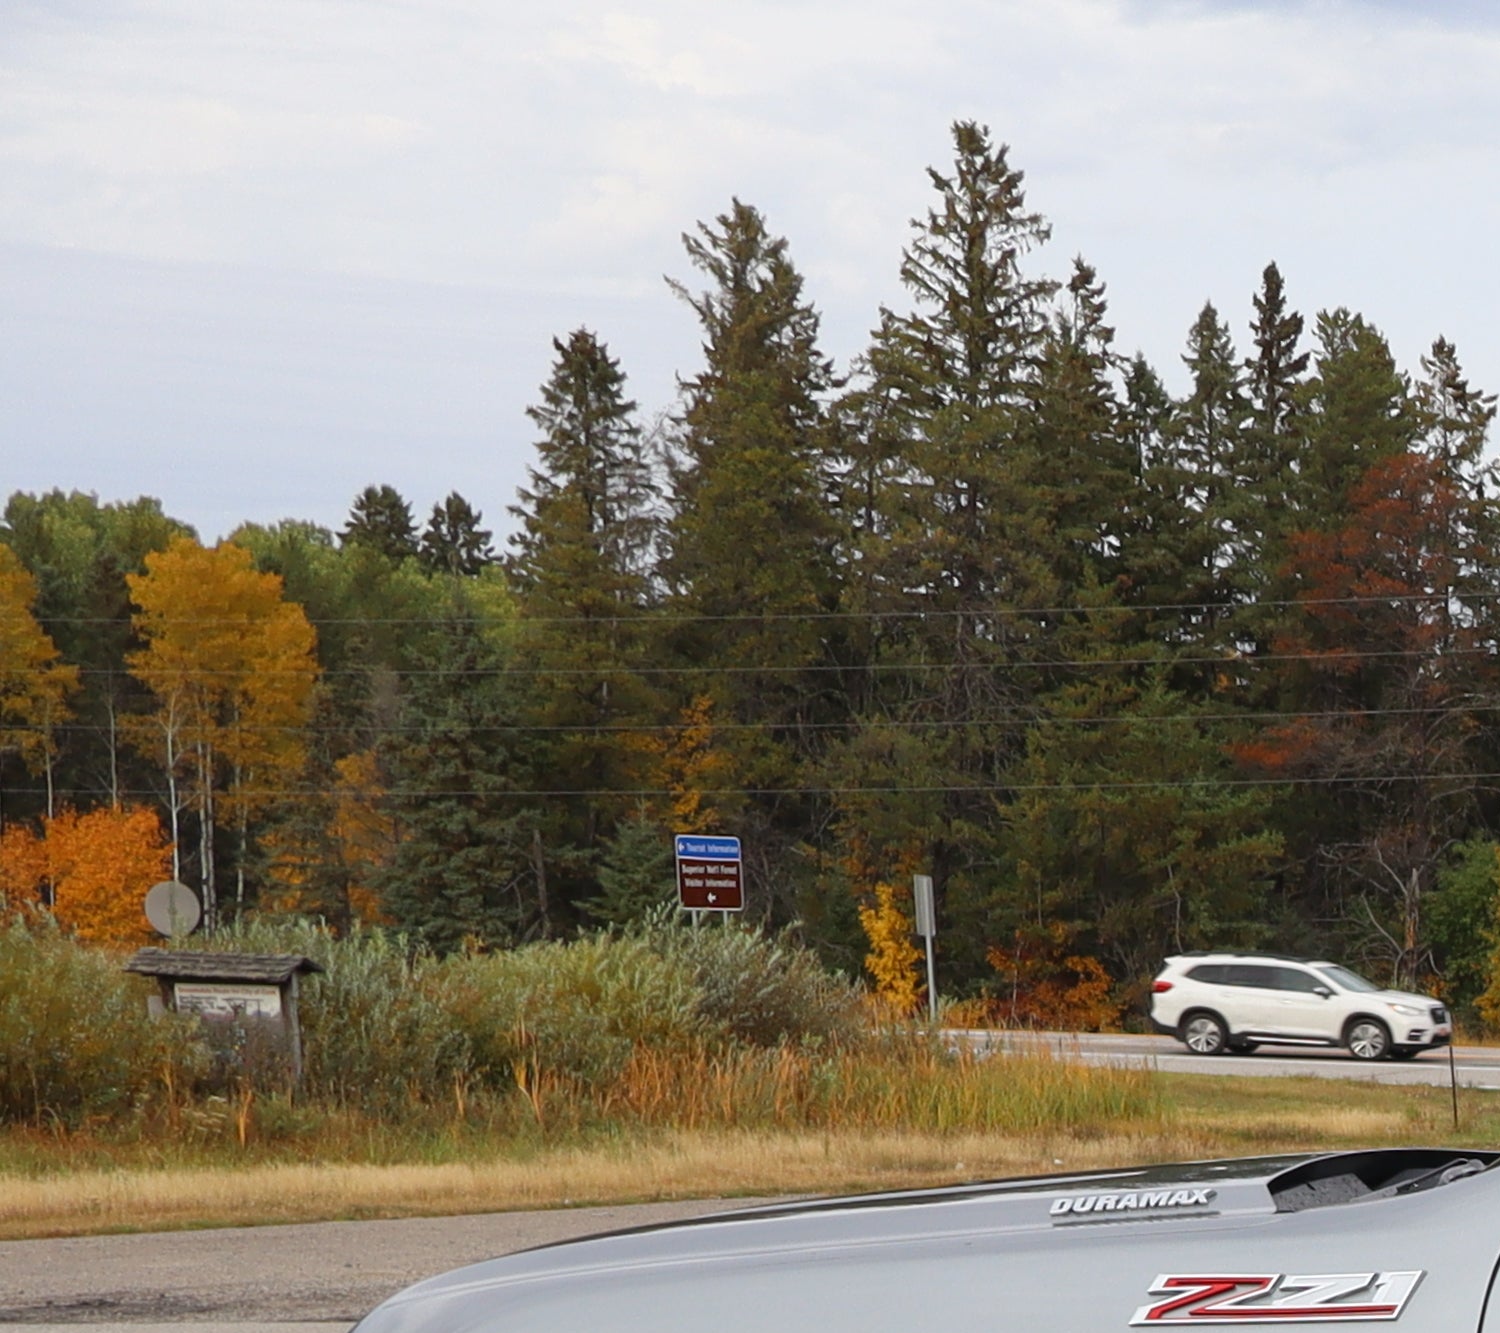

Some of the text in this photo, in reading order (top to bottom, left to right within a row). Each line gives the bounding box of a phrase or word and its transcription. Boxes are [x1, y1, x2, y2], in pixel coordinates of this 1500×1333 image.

[686, 843, 739, 854] Tourist Information
[681, 864, 705, 875] Superior
[705, 878, 737, 888] Information
[1050, 1187, 1216, 1215] DURAMAX
[1128, 1269, 1425, 1326] Z71
